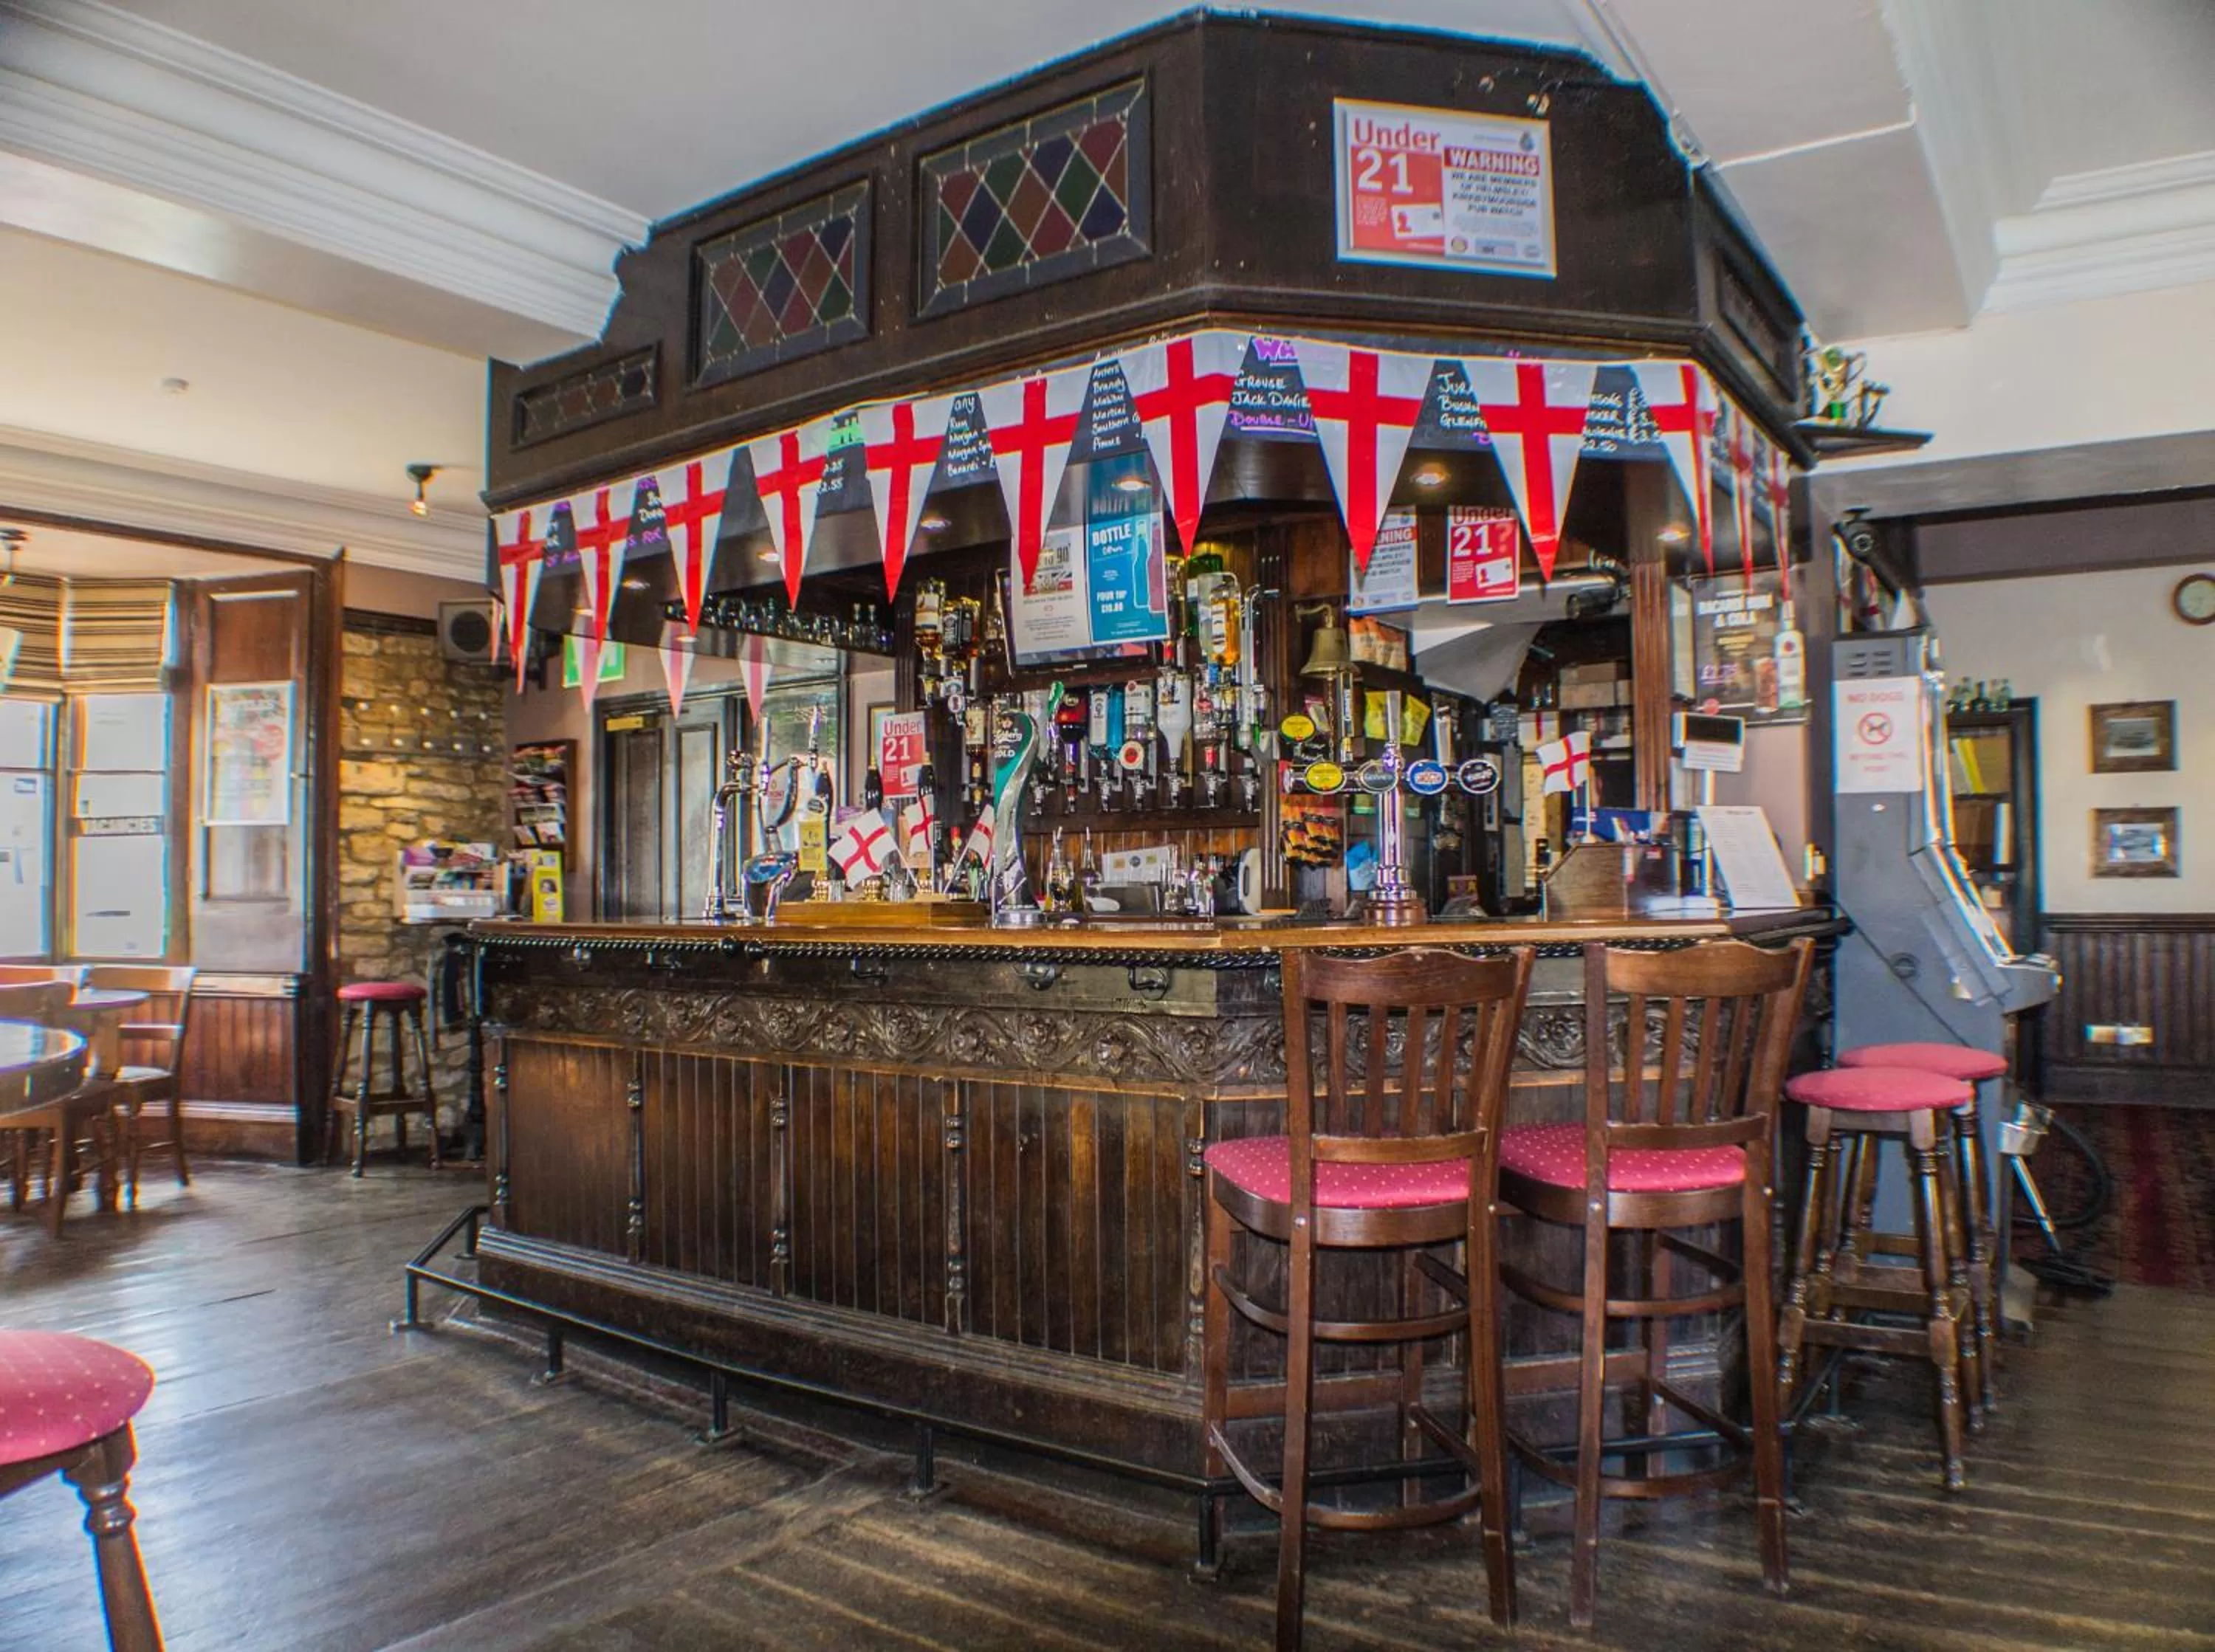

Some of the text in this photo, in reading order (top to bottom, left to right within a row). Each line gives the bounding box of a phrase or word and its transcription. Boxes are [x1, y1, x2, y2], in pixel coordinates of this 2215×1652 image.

[1354, 118, 1441, 151] Under
[1357, 148, 1414, 194] 21
[1450, 148, 1538, 175] WARNING
[1268, 391, 1312, 408] DANIE
[1093, 523, 1132, 546] BOTTLE
[1377, 527, 1412, 545] NING
[885, 719, 922, 736] Under
[885, 737, 910, 762] 21
